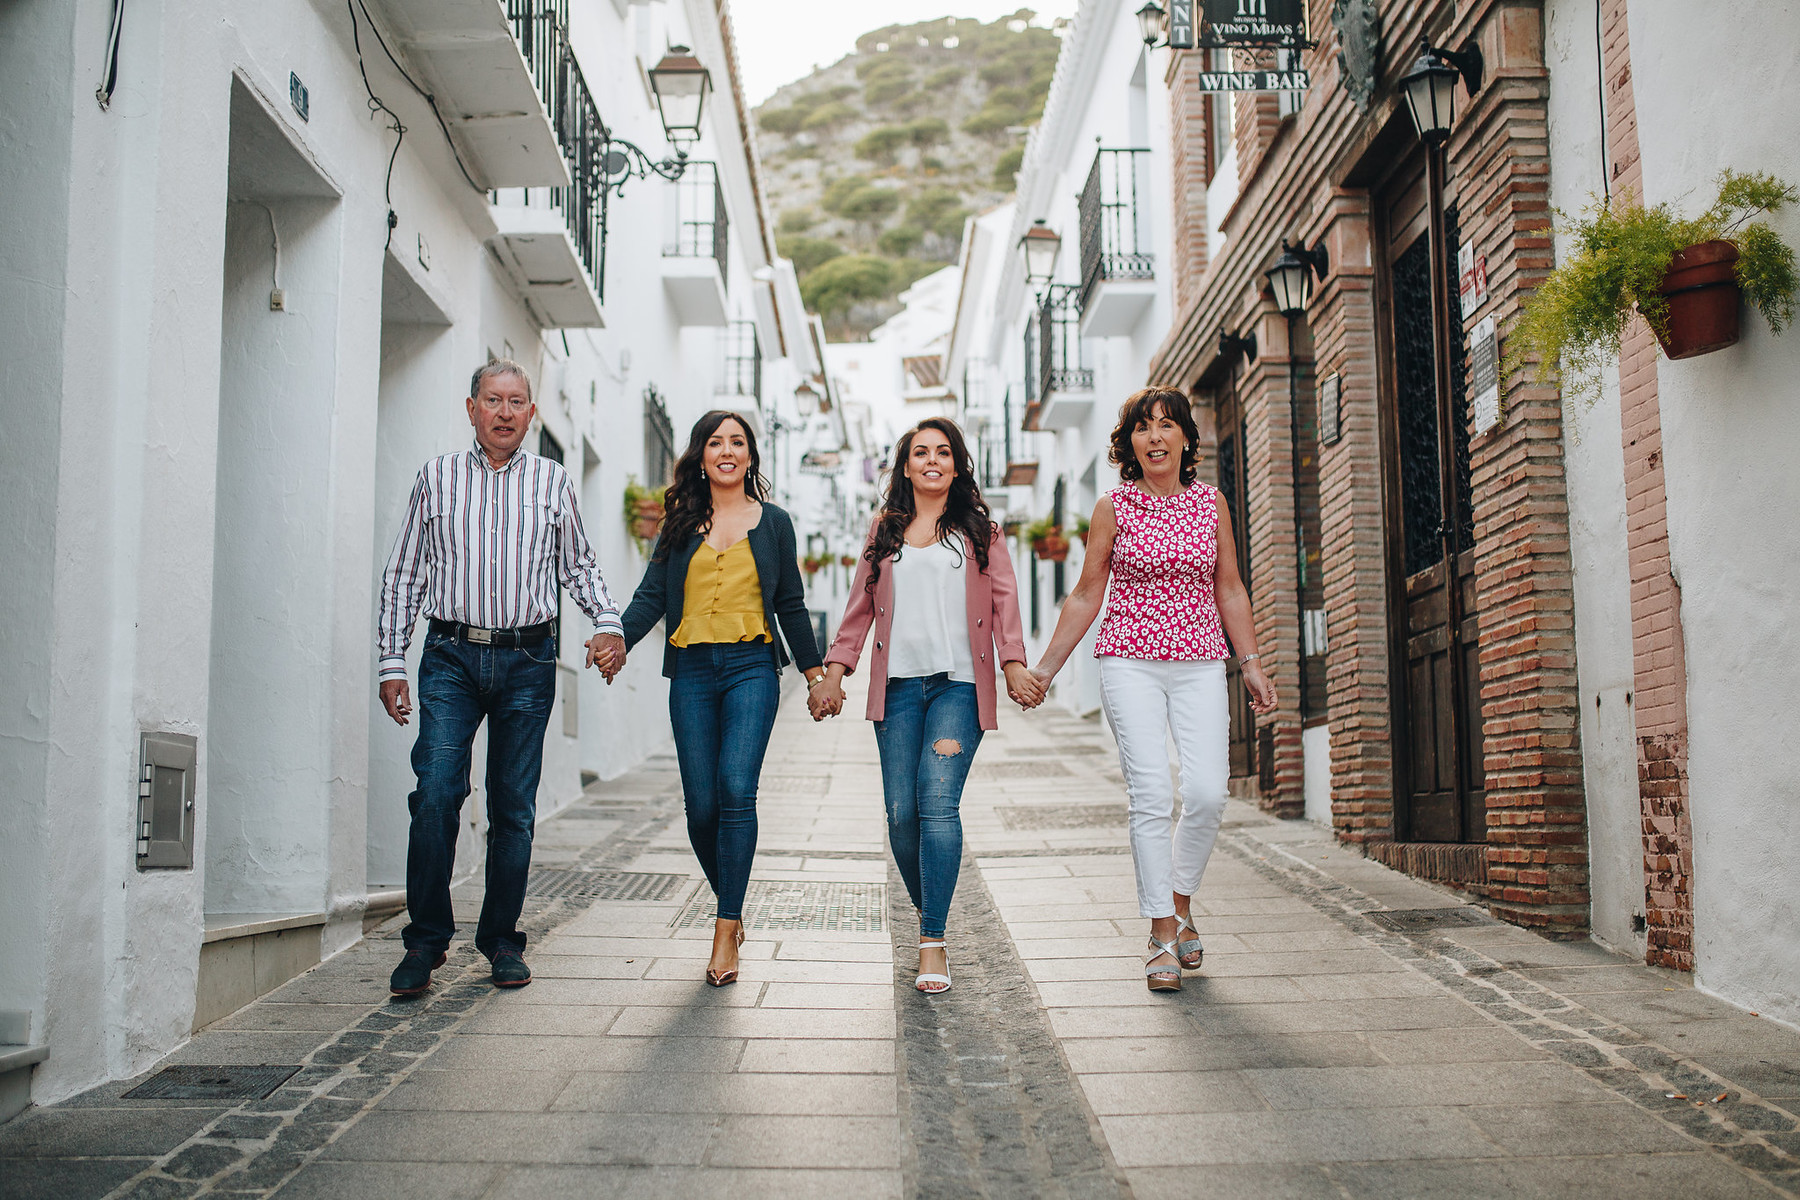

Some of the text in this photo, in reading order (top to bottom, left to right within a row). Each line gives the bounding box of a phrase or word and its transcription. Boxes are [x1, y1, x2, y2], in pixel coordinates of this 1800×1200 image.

[1173, 0, 1190, 44] NT
[1212, 22, 1293, 36] VINO MIJAS
[1201, 72, 1307, 90] WINE BAR
[298, 84, 304, 109] 9
